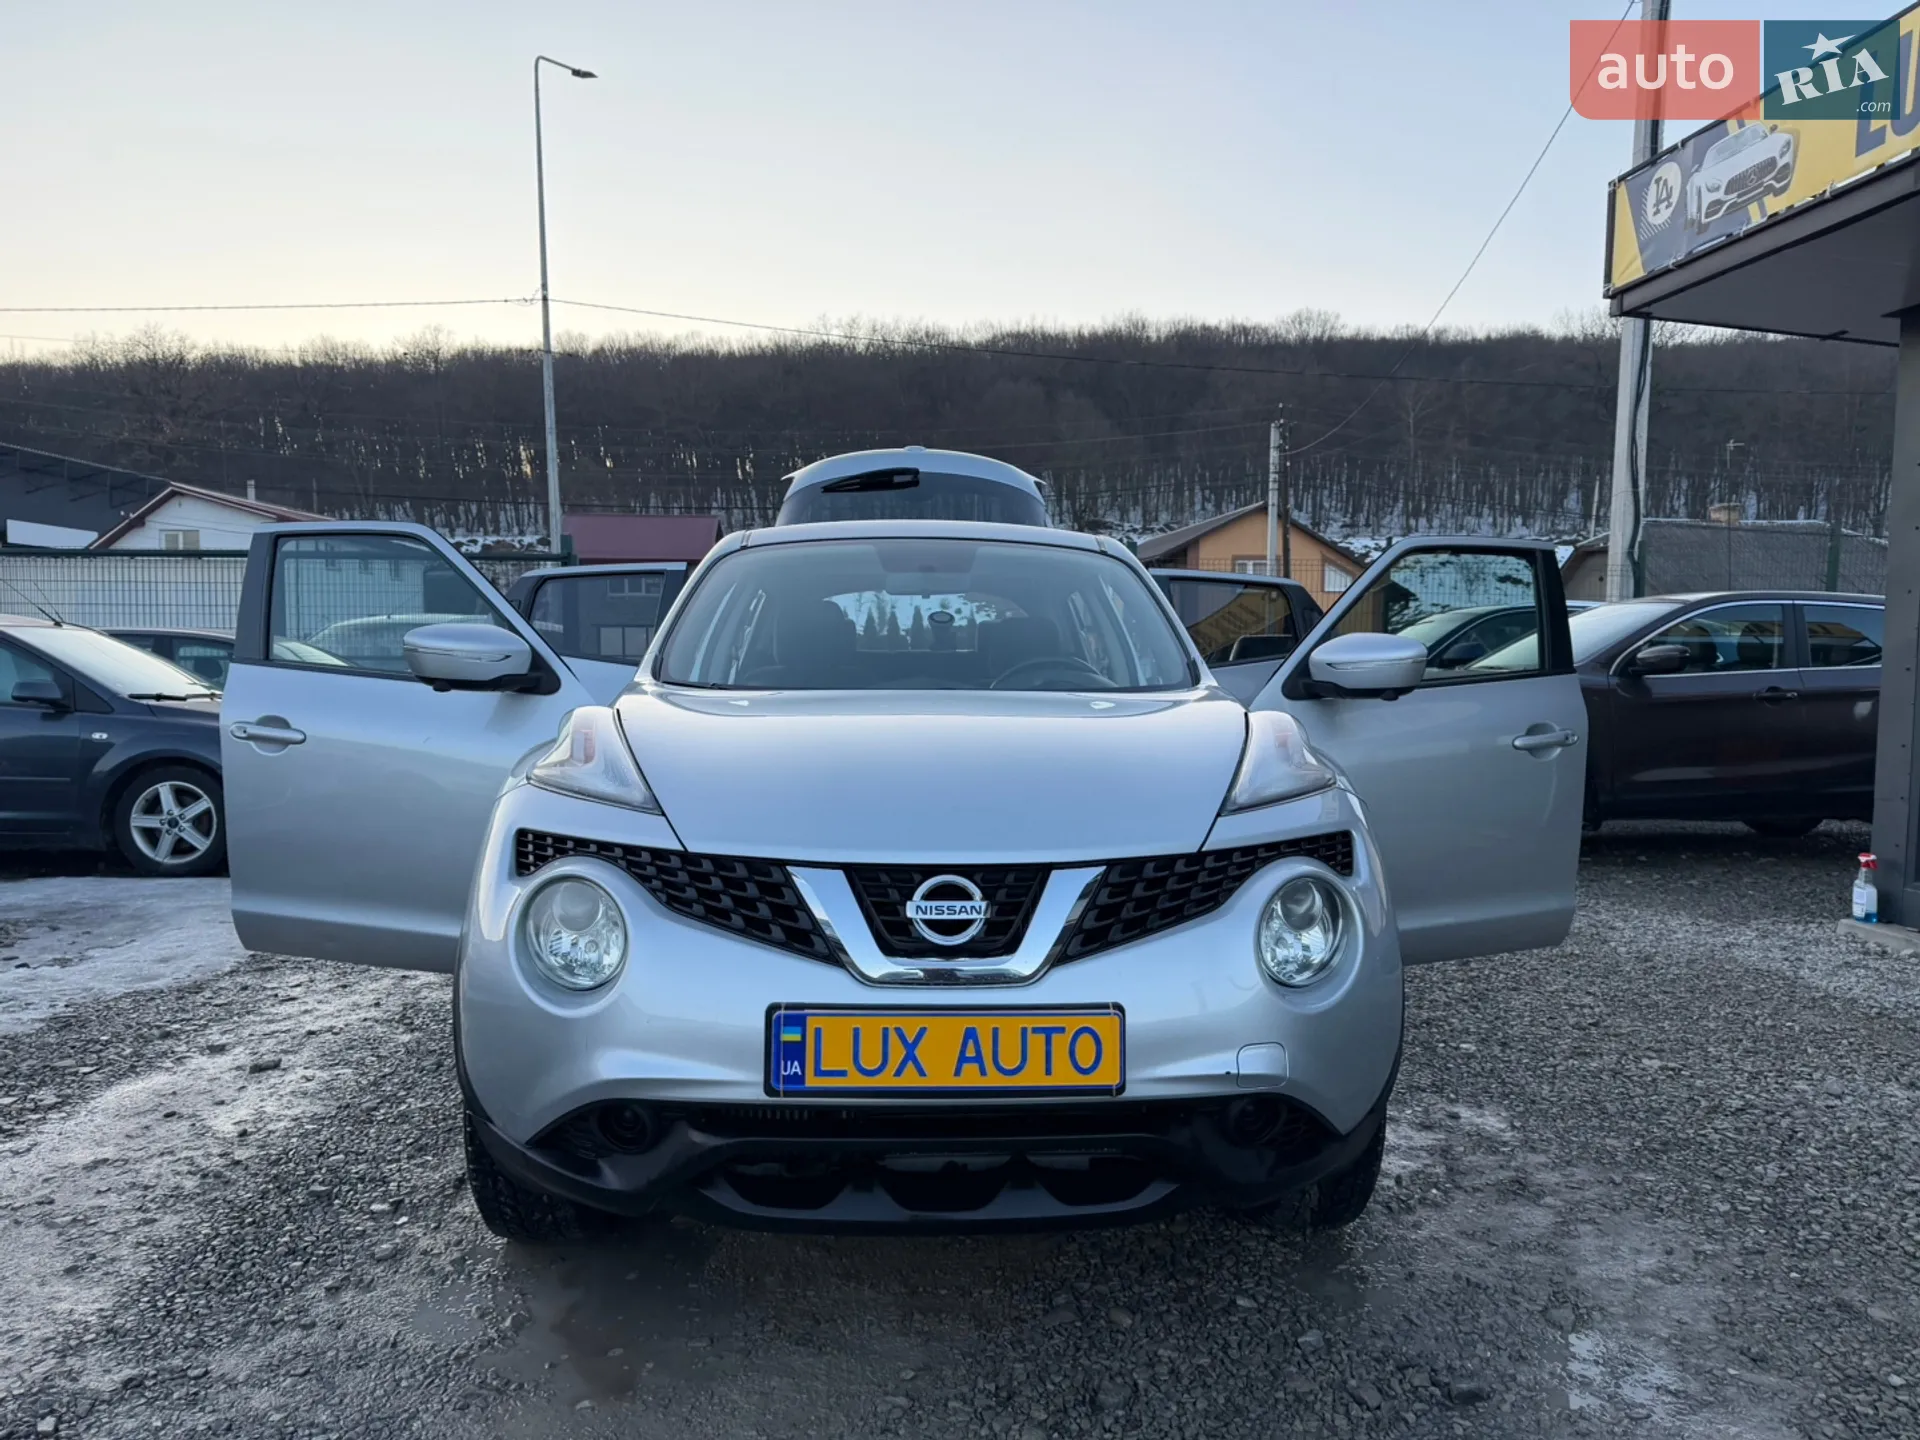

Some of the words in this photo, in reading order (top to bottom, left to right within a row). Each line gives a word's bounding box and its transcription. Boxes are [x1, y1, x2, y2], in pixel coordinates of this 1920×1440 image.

[915, 905, 982, 916] NISSAN
[813, 1026, 928, 1077] LUX
[953, 1026, 1103, 1077] AUTO
[781, 1060, 802, 1076] UA
